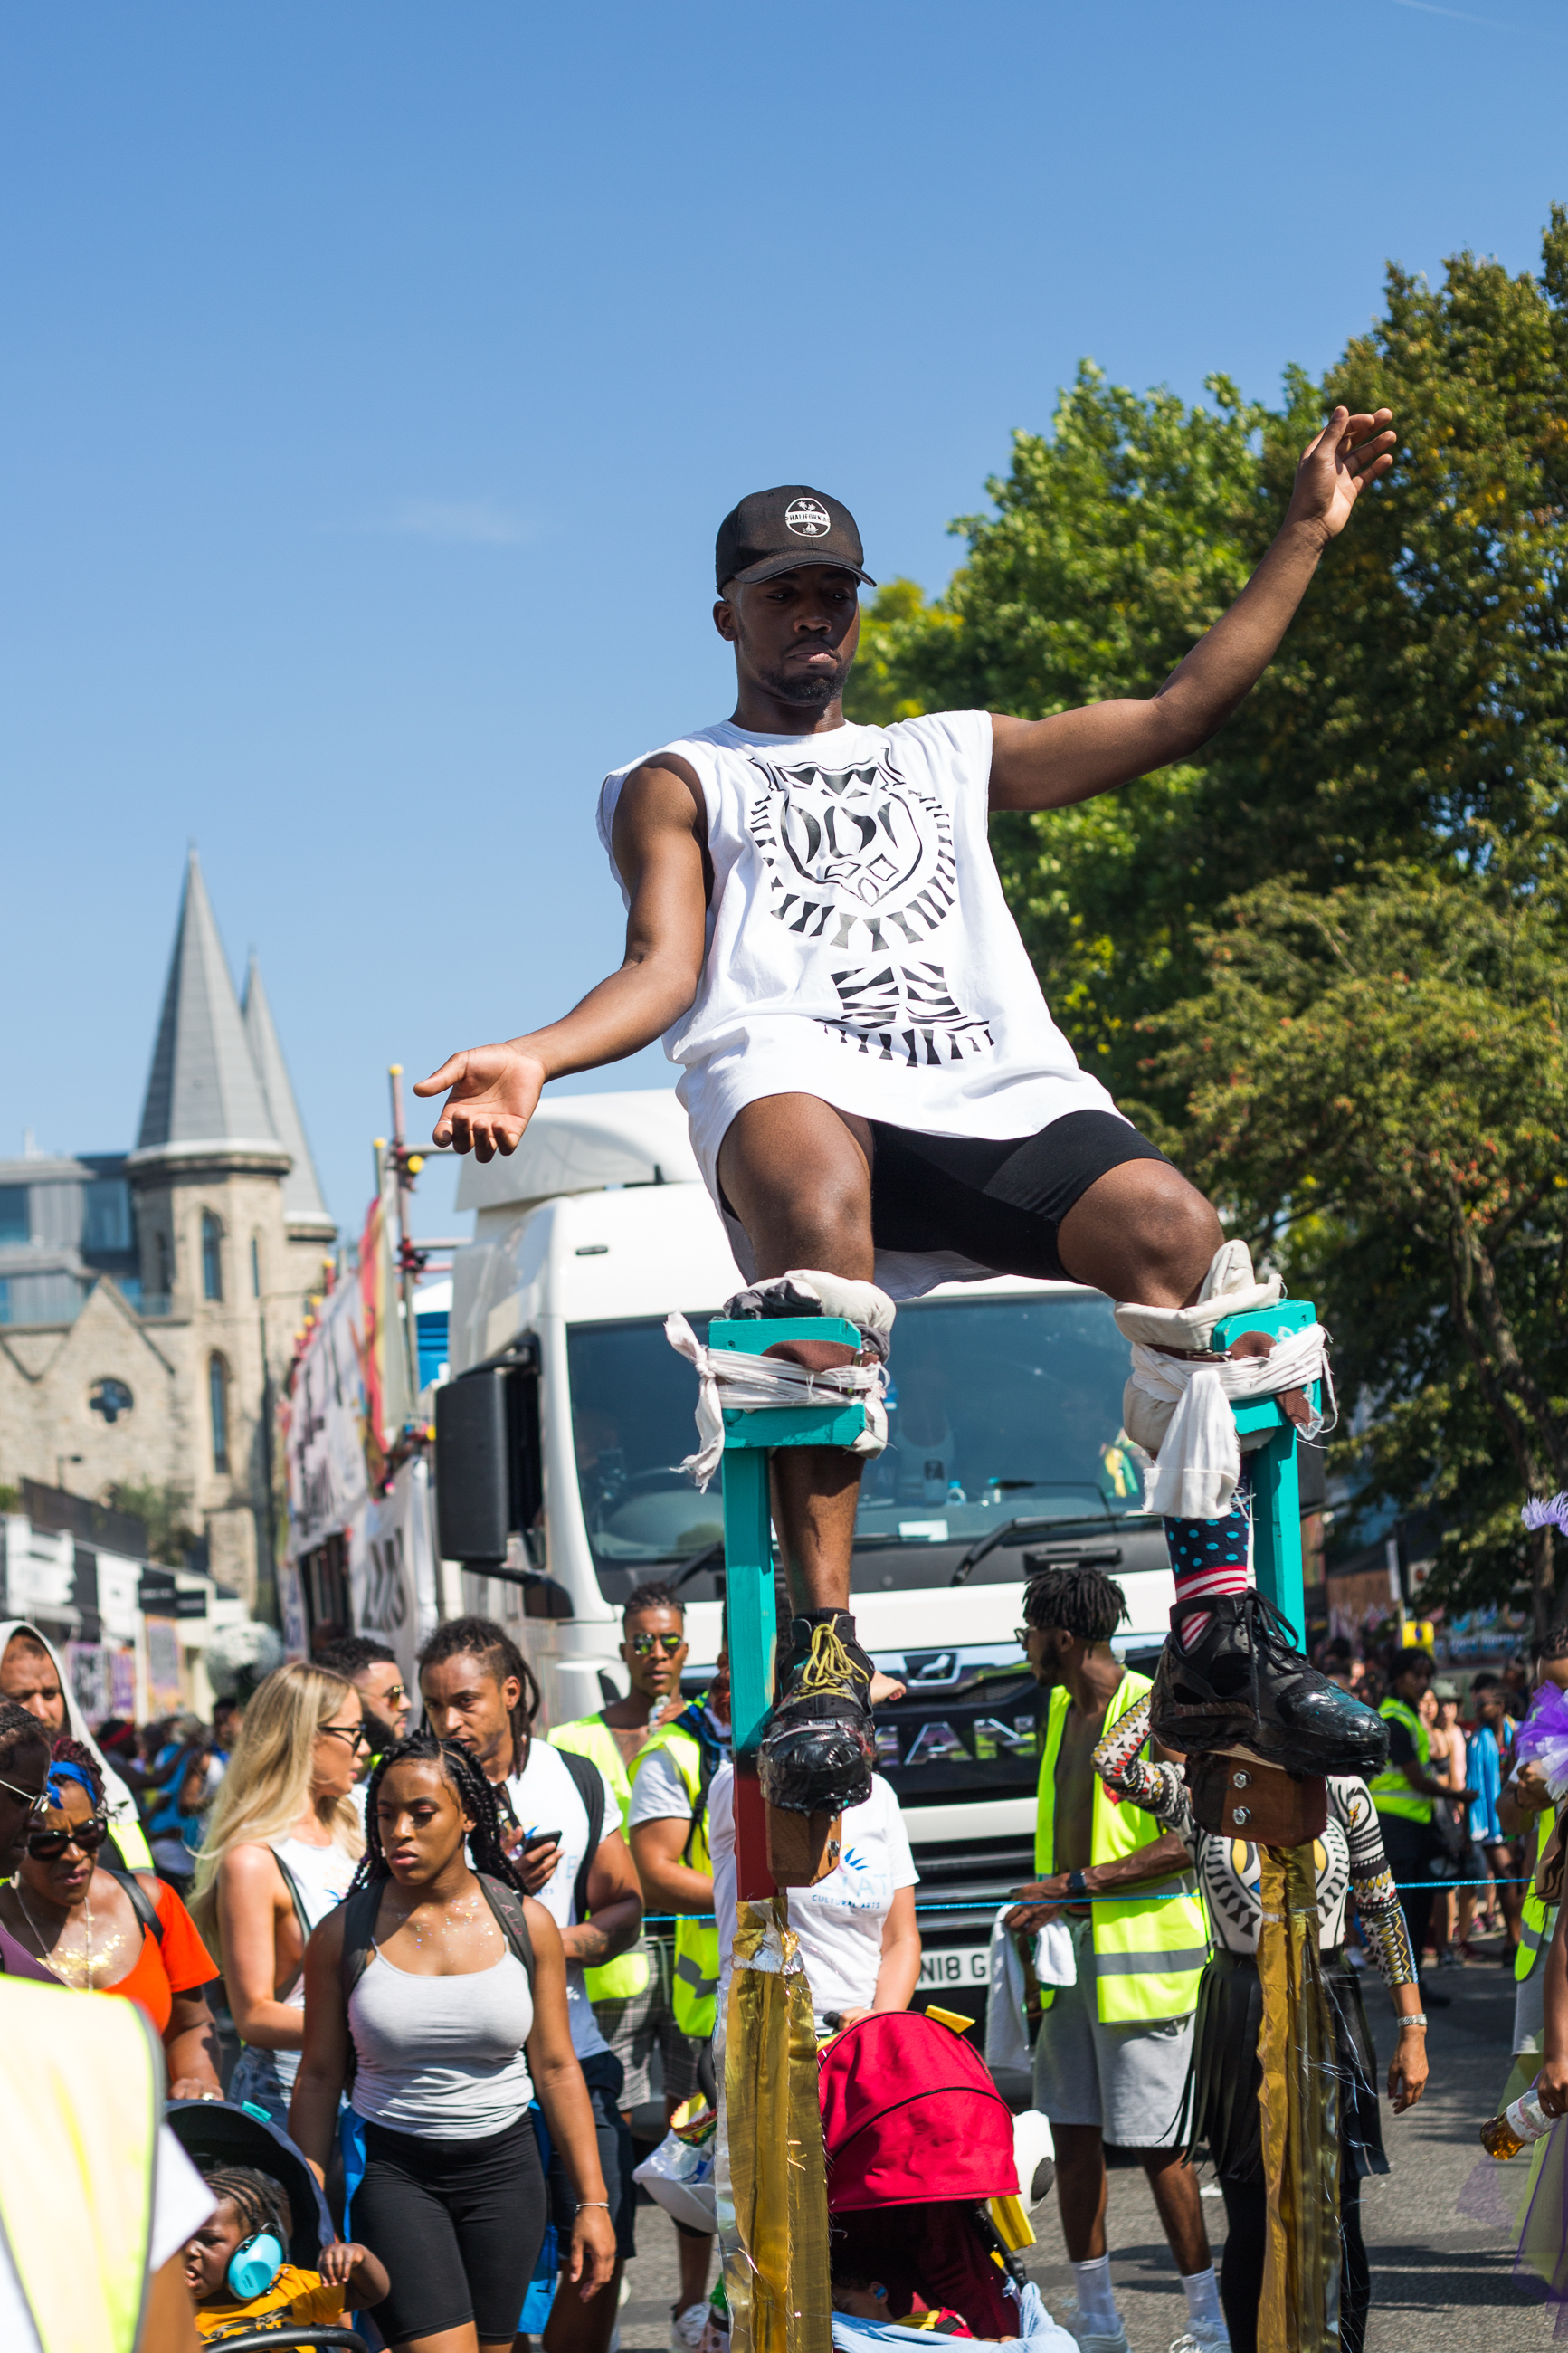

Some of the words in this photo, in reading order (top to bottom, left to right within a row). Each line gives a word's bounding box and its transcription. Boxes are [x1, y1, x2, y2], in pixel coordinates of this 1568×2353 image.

[789, 513, 827, 522] HALIFORNIA
[812, 1894, 857, 1909] CULTURAL
[860, 1901, 881, 1910] ARTS
[500, 1903, 523, 1936] AIR
[971, 1954, 986, 1978] G
